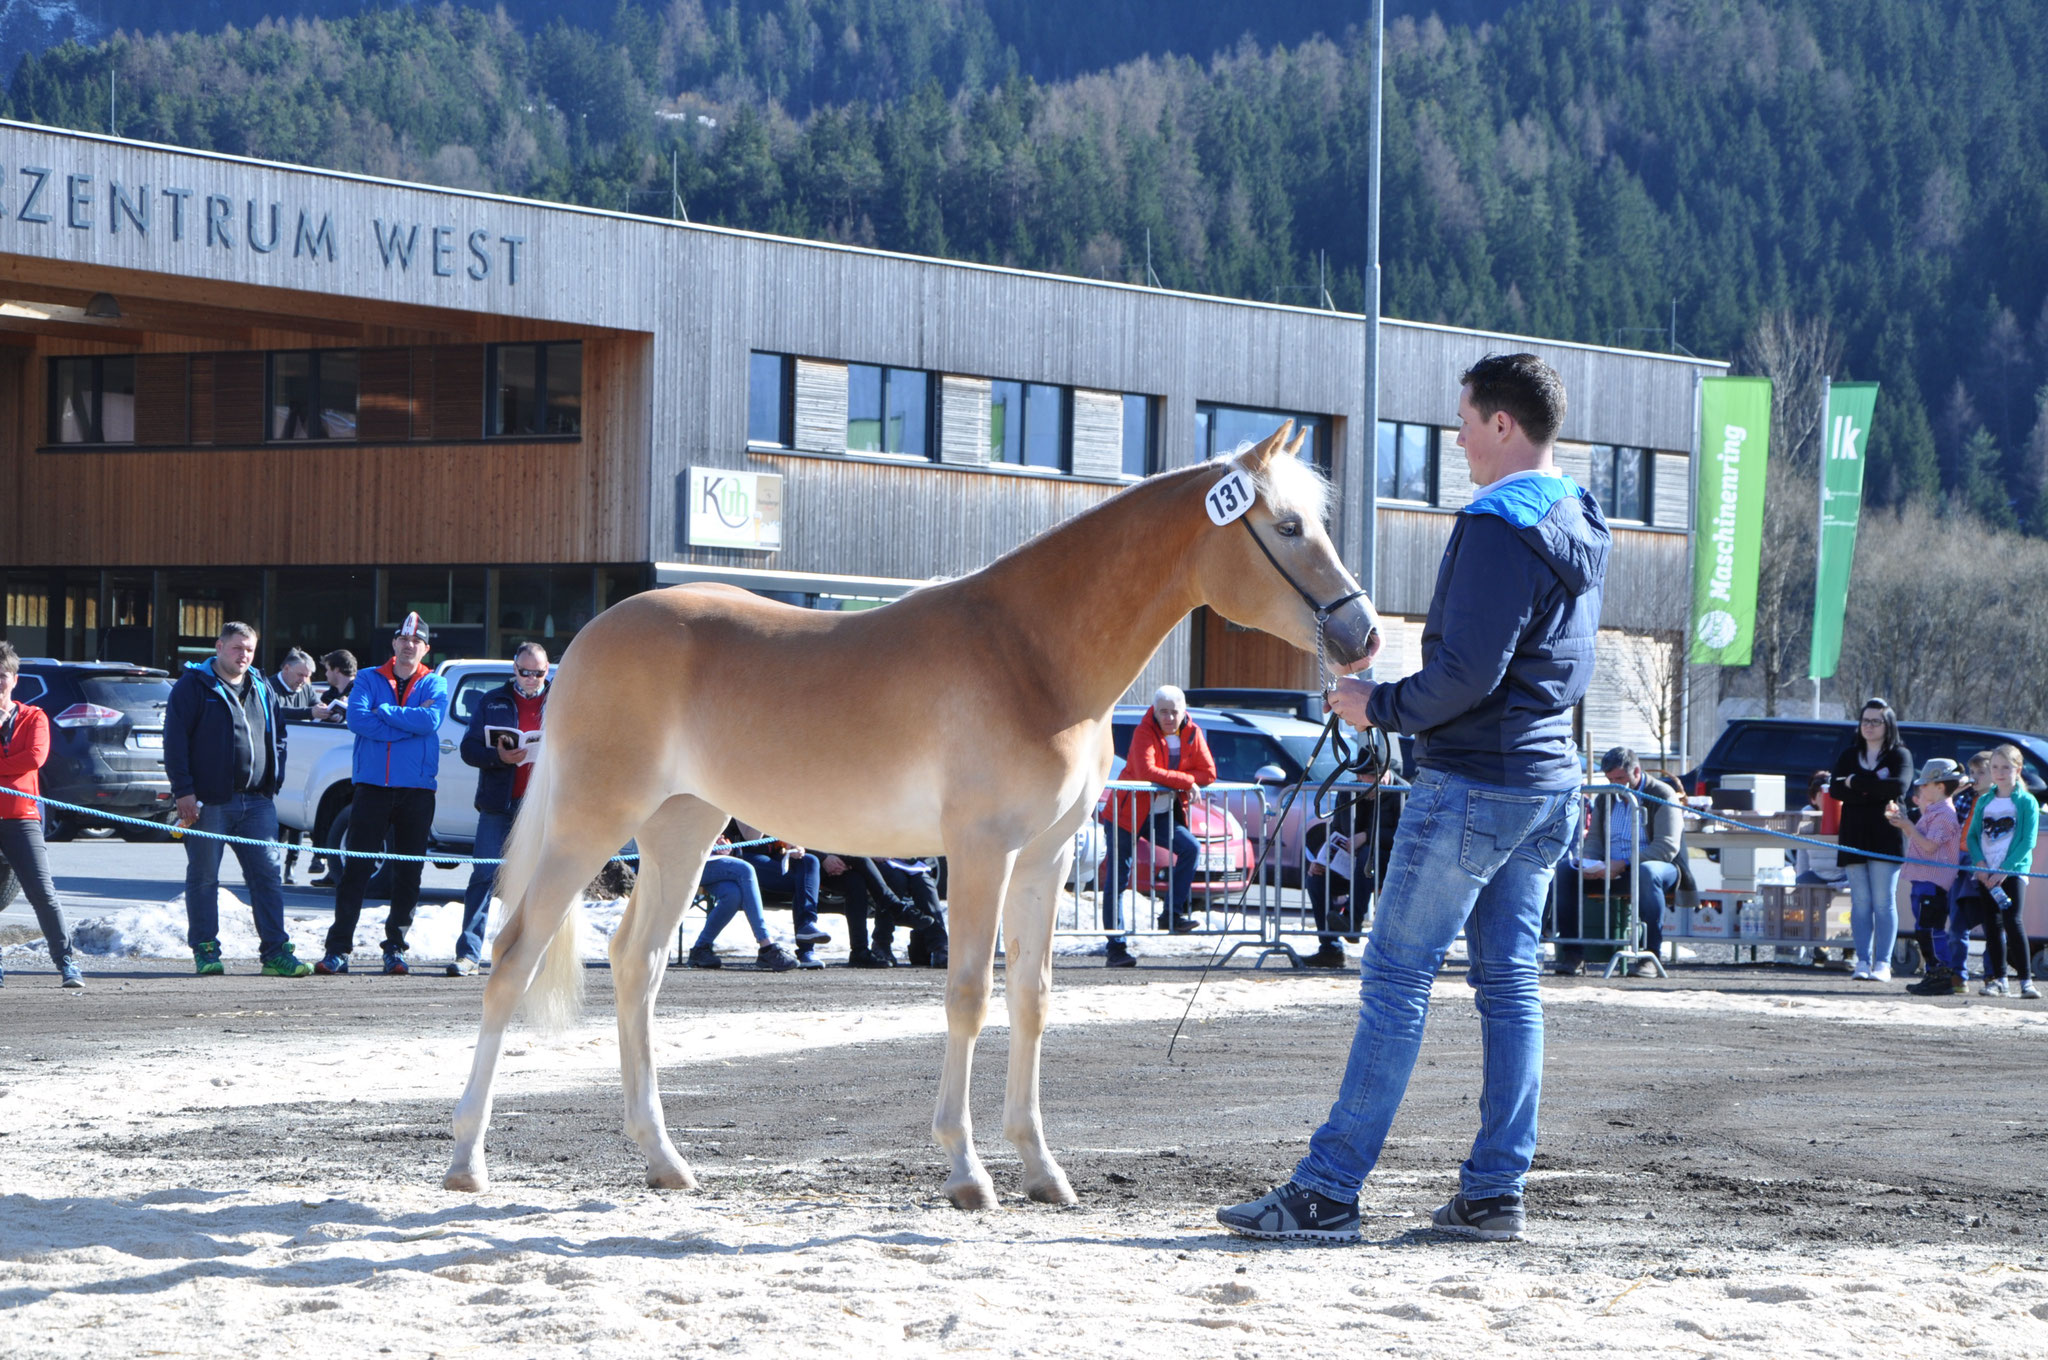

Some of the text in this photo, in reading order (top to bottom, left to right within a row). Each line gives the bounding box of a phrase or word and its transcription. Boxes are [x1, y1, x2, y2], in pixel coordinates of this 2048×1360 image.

[372, 216, 528, 286] WEST
[1209, 475, 1249, 519] 131
[1708, 423, 1747, 602] Maschinenring
